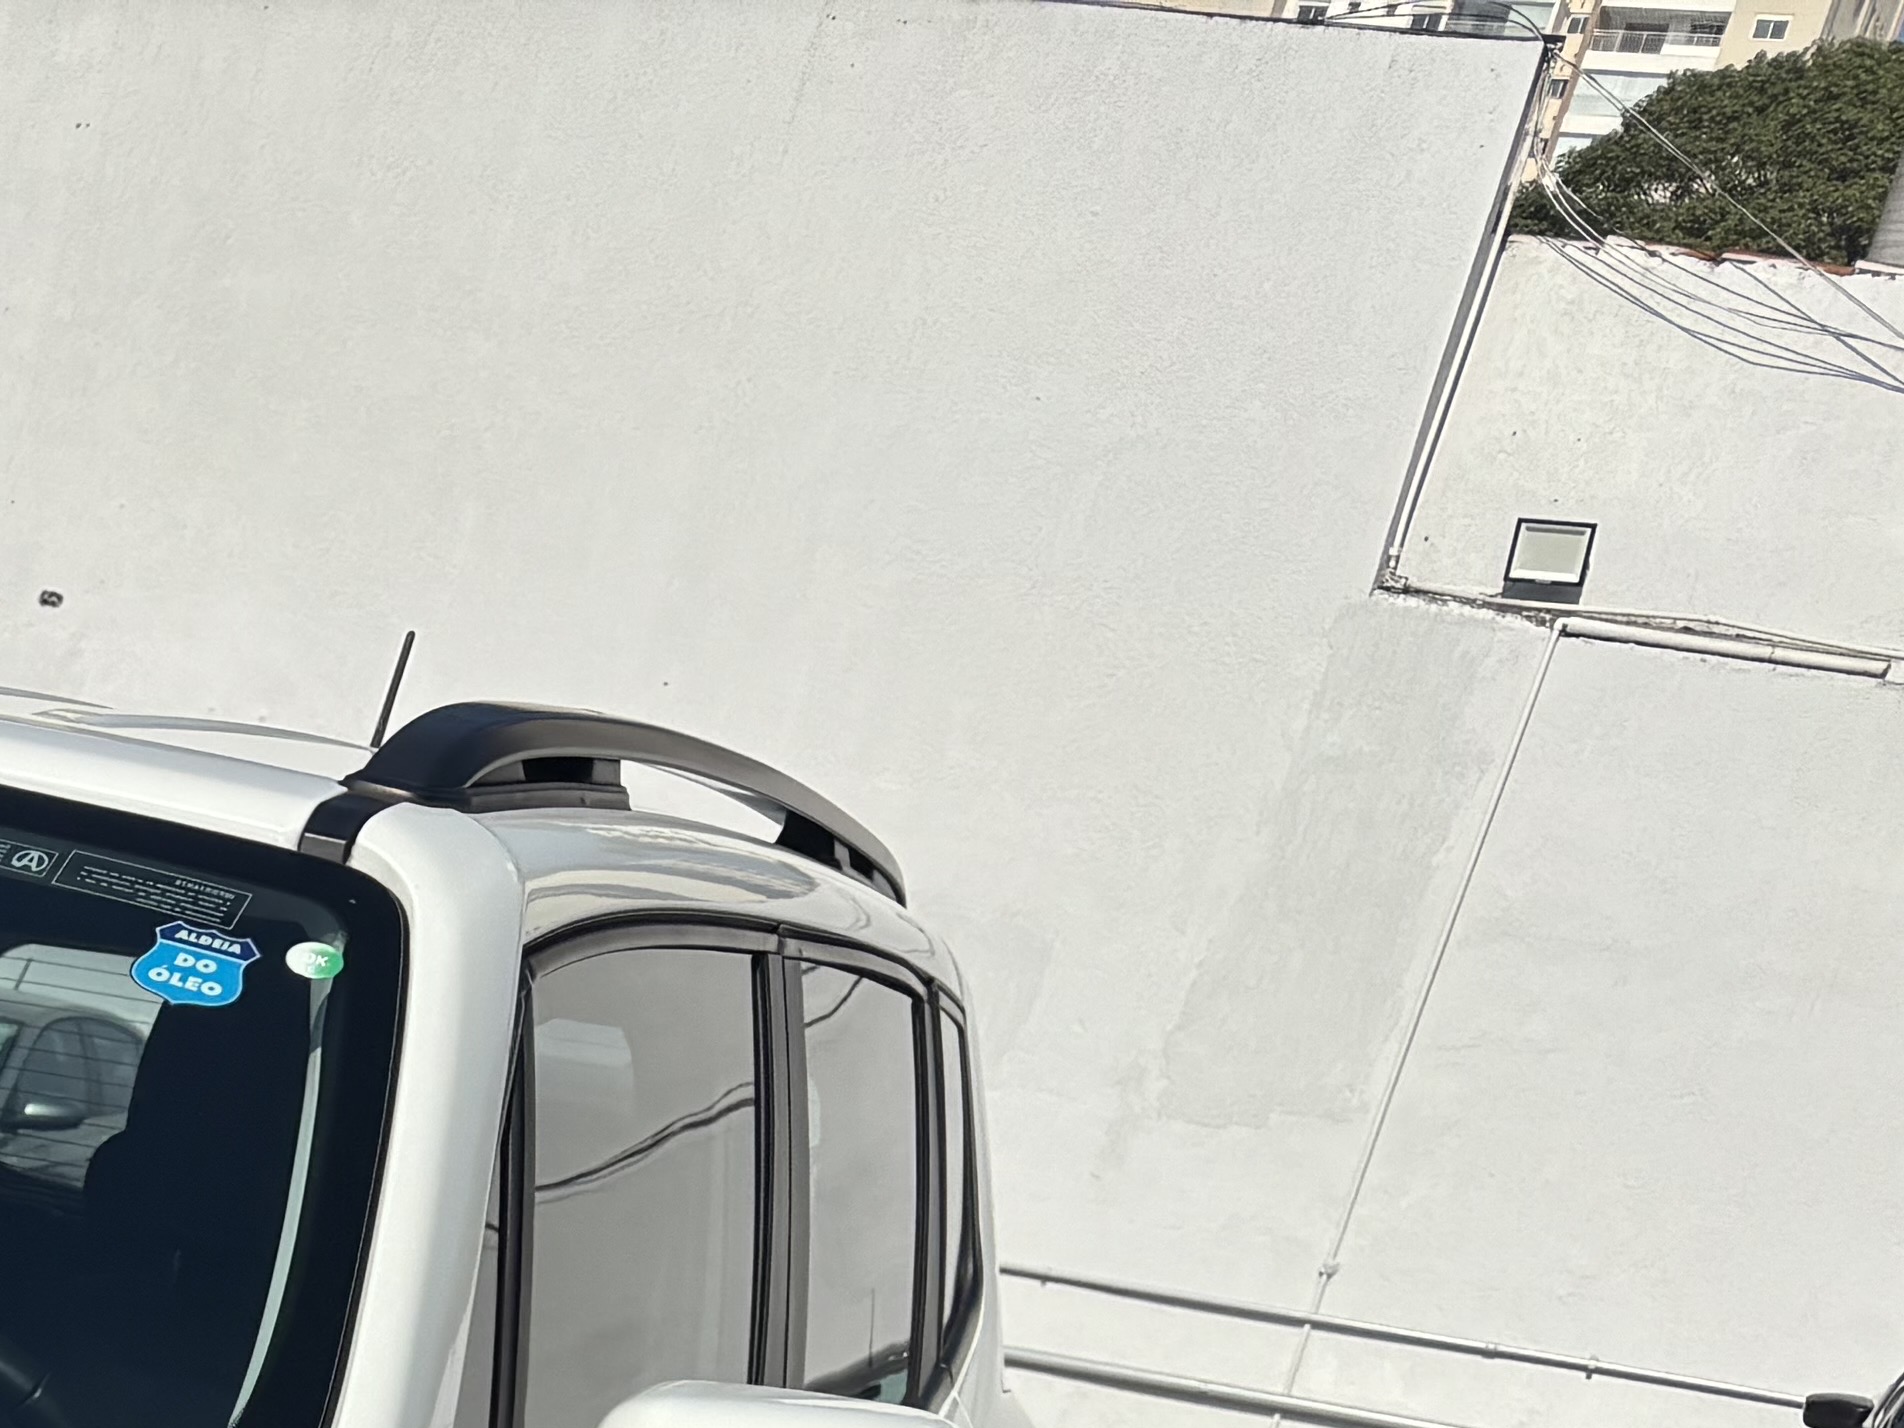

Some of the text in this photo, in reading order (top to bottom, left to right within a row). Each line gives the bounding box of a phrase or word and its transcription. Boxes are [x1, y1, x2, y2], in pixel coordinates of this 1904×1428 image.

[174, 929, 242, 955] ALDEIA
[173, 952, 218, 974] DO
[147, 964, 223, 996] ÓLEO
